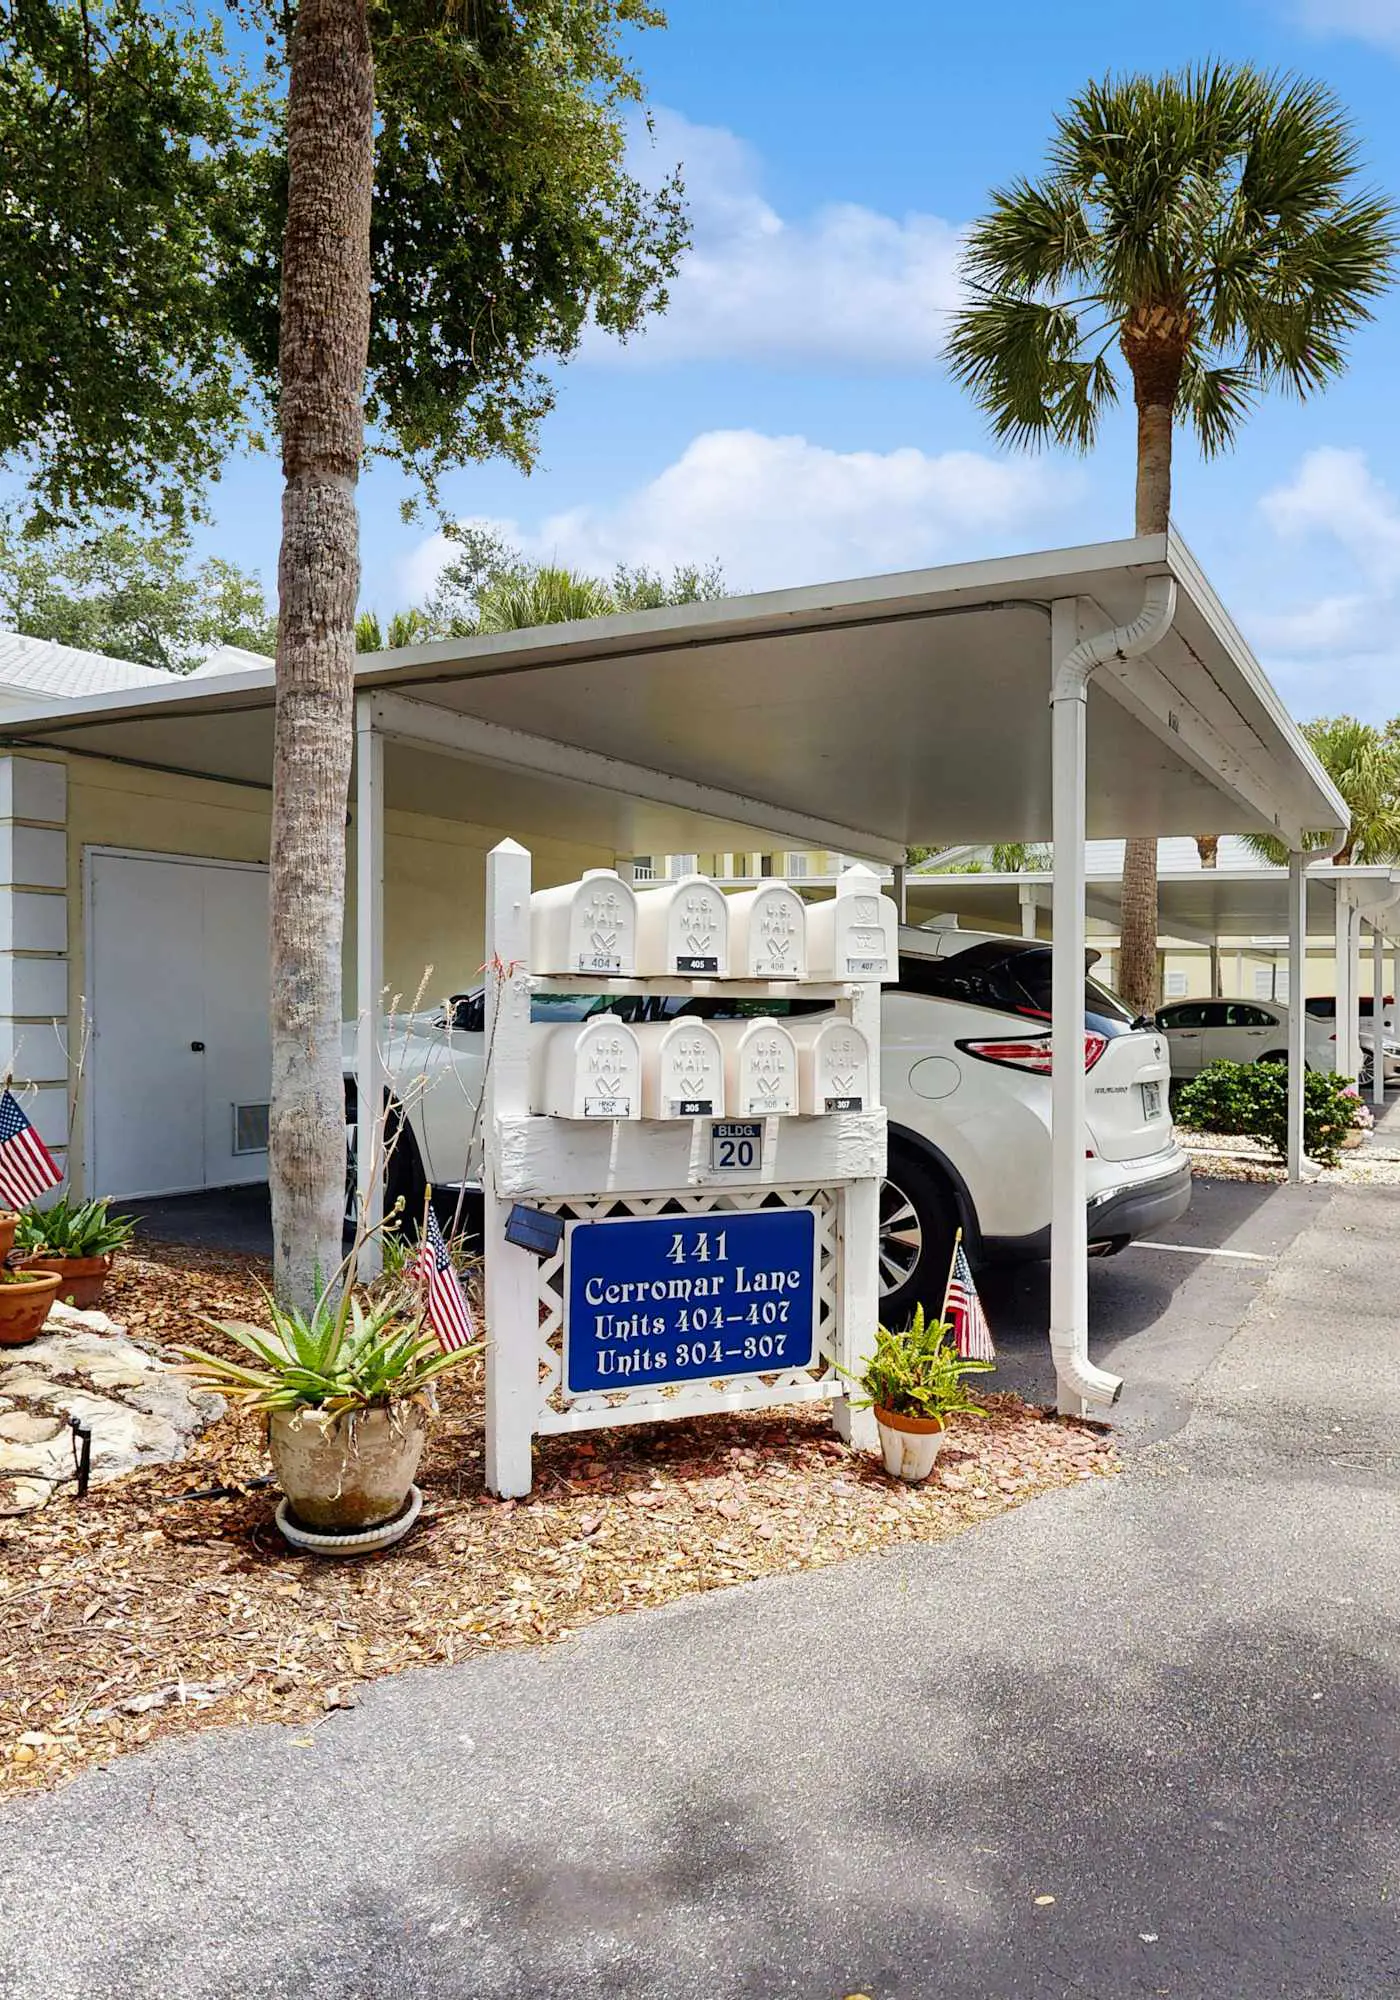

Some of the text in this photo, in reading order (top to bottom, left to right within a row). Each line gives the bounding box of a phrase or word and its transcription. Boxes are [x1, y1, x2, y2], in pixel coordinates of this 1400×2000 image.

[591, 892, 620, 908] U.S.
[687, 897, 713, 912] U.S.
[766, 903, 791, 918] U.S.
[583, 909, 624, 929] MAIL
[680, 916, 717, 932] MAIL
[760, 919, 796, 935] MAIL
[592, 958, 610, 969] 404
[690, 960, 705, 969] 405
[861, 962, 874, 970] 407
[597, 1040, 624, 1056] U.S.
[680, 1040, 706, 1056] U.S.
[756, 1040, 781, 1056] U.S.
[589, 1056, 628, 1073] MAIL
[673, 1056, 710, 1073] MAIL
[751, 1058, 785, 1073] MAIL
[825, 1056, 859, 1071] MAIL
[837, 1100, 851, 1109] 307
[718, 1125, 755, 1136] BLDG.
[720, 1140, 753, 1167] 20
[666, 1230, 729, 1265] 441
[585, 1266, 800, 1306] Cerromar Lane
[594, 1314, 666, 1342] Units
[597, 1347, 668, 1377] Units
